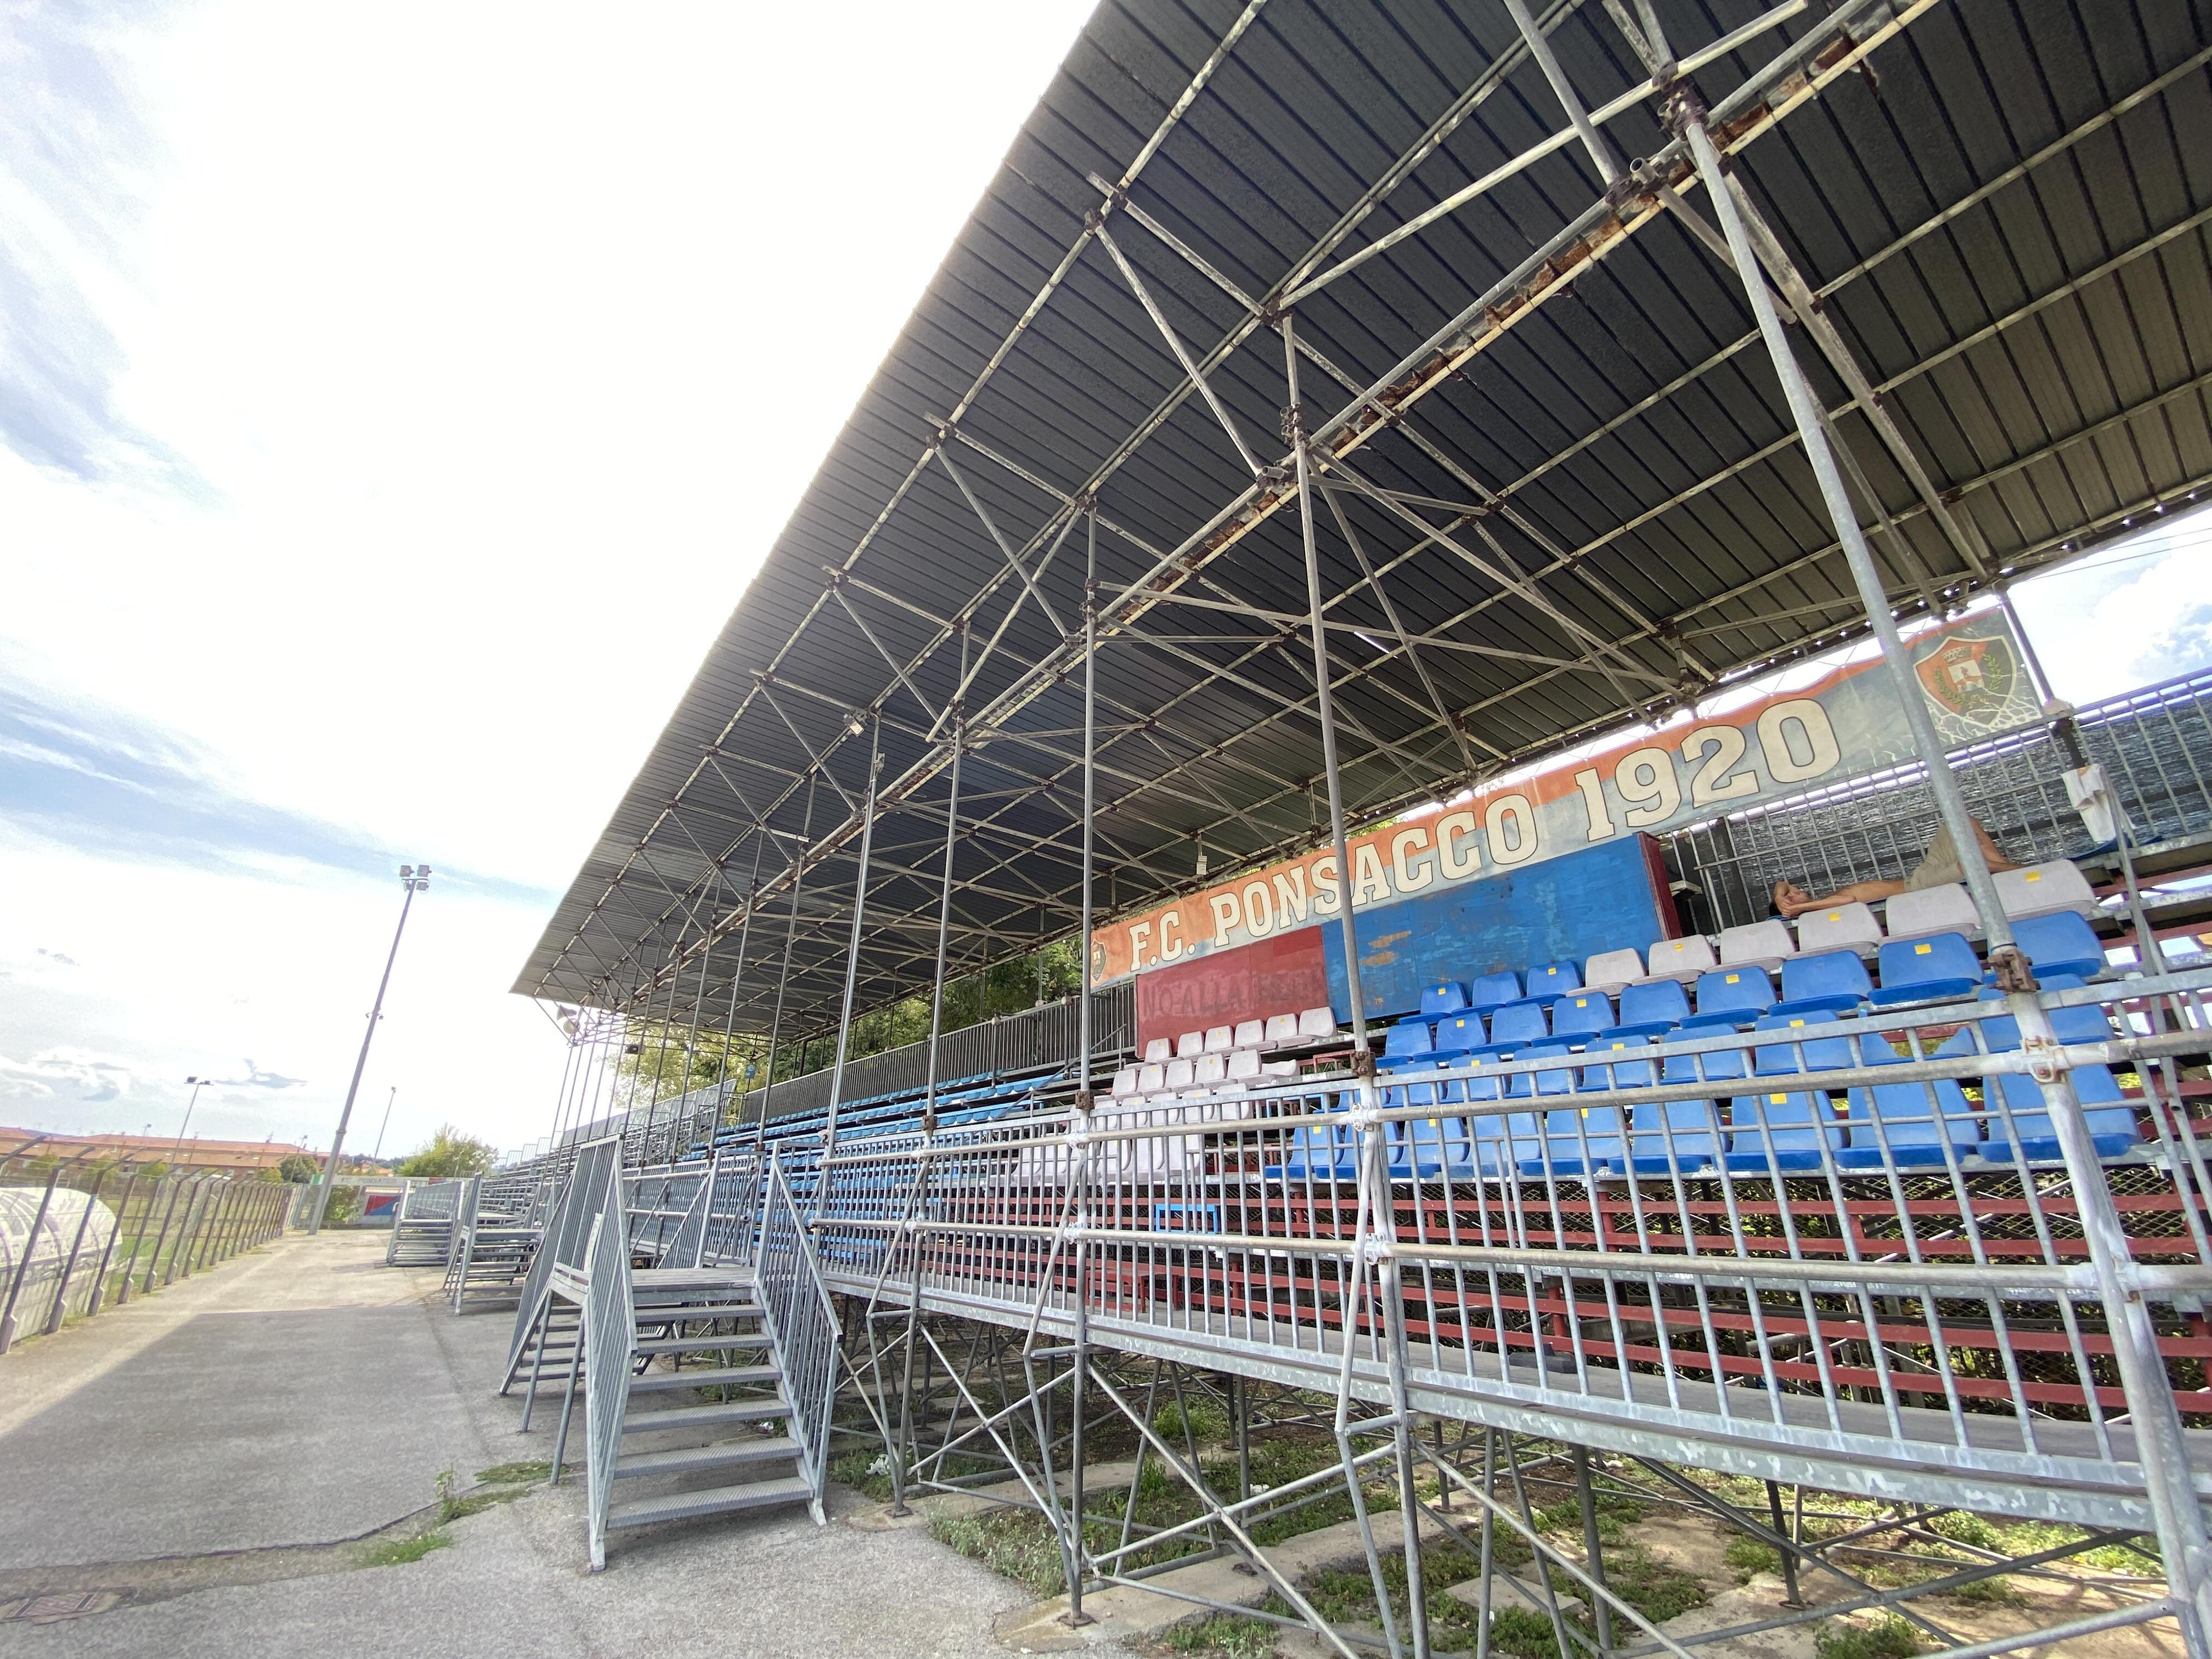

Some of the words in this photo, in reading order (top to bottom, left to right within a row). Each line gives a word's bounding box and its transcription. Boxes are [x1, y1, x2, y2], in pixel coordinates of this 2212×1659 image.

[1128, 910, 1195, 972] F.C.
[1209, 793, 1538, 947] PONSACCO
[1575, 698, 1841, 842] 1920
